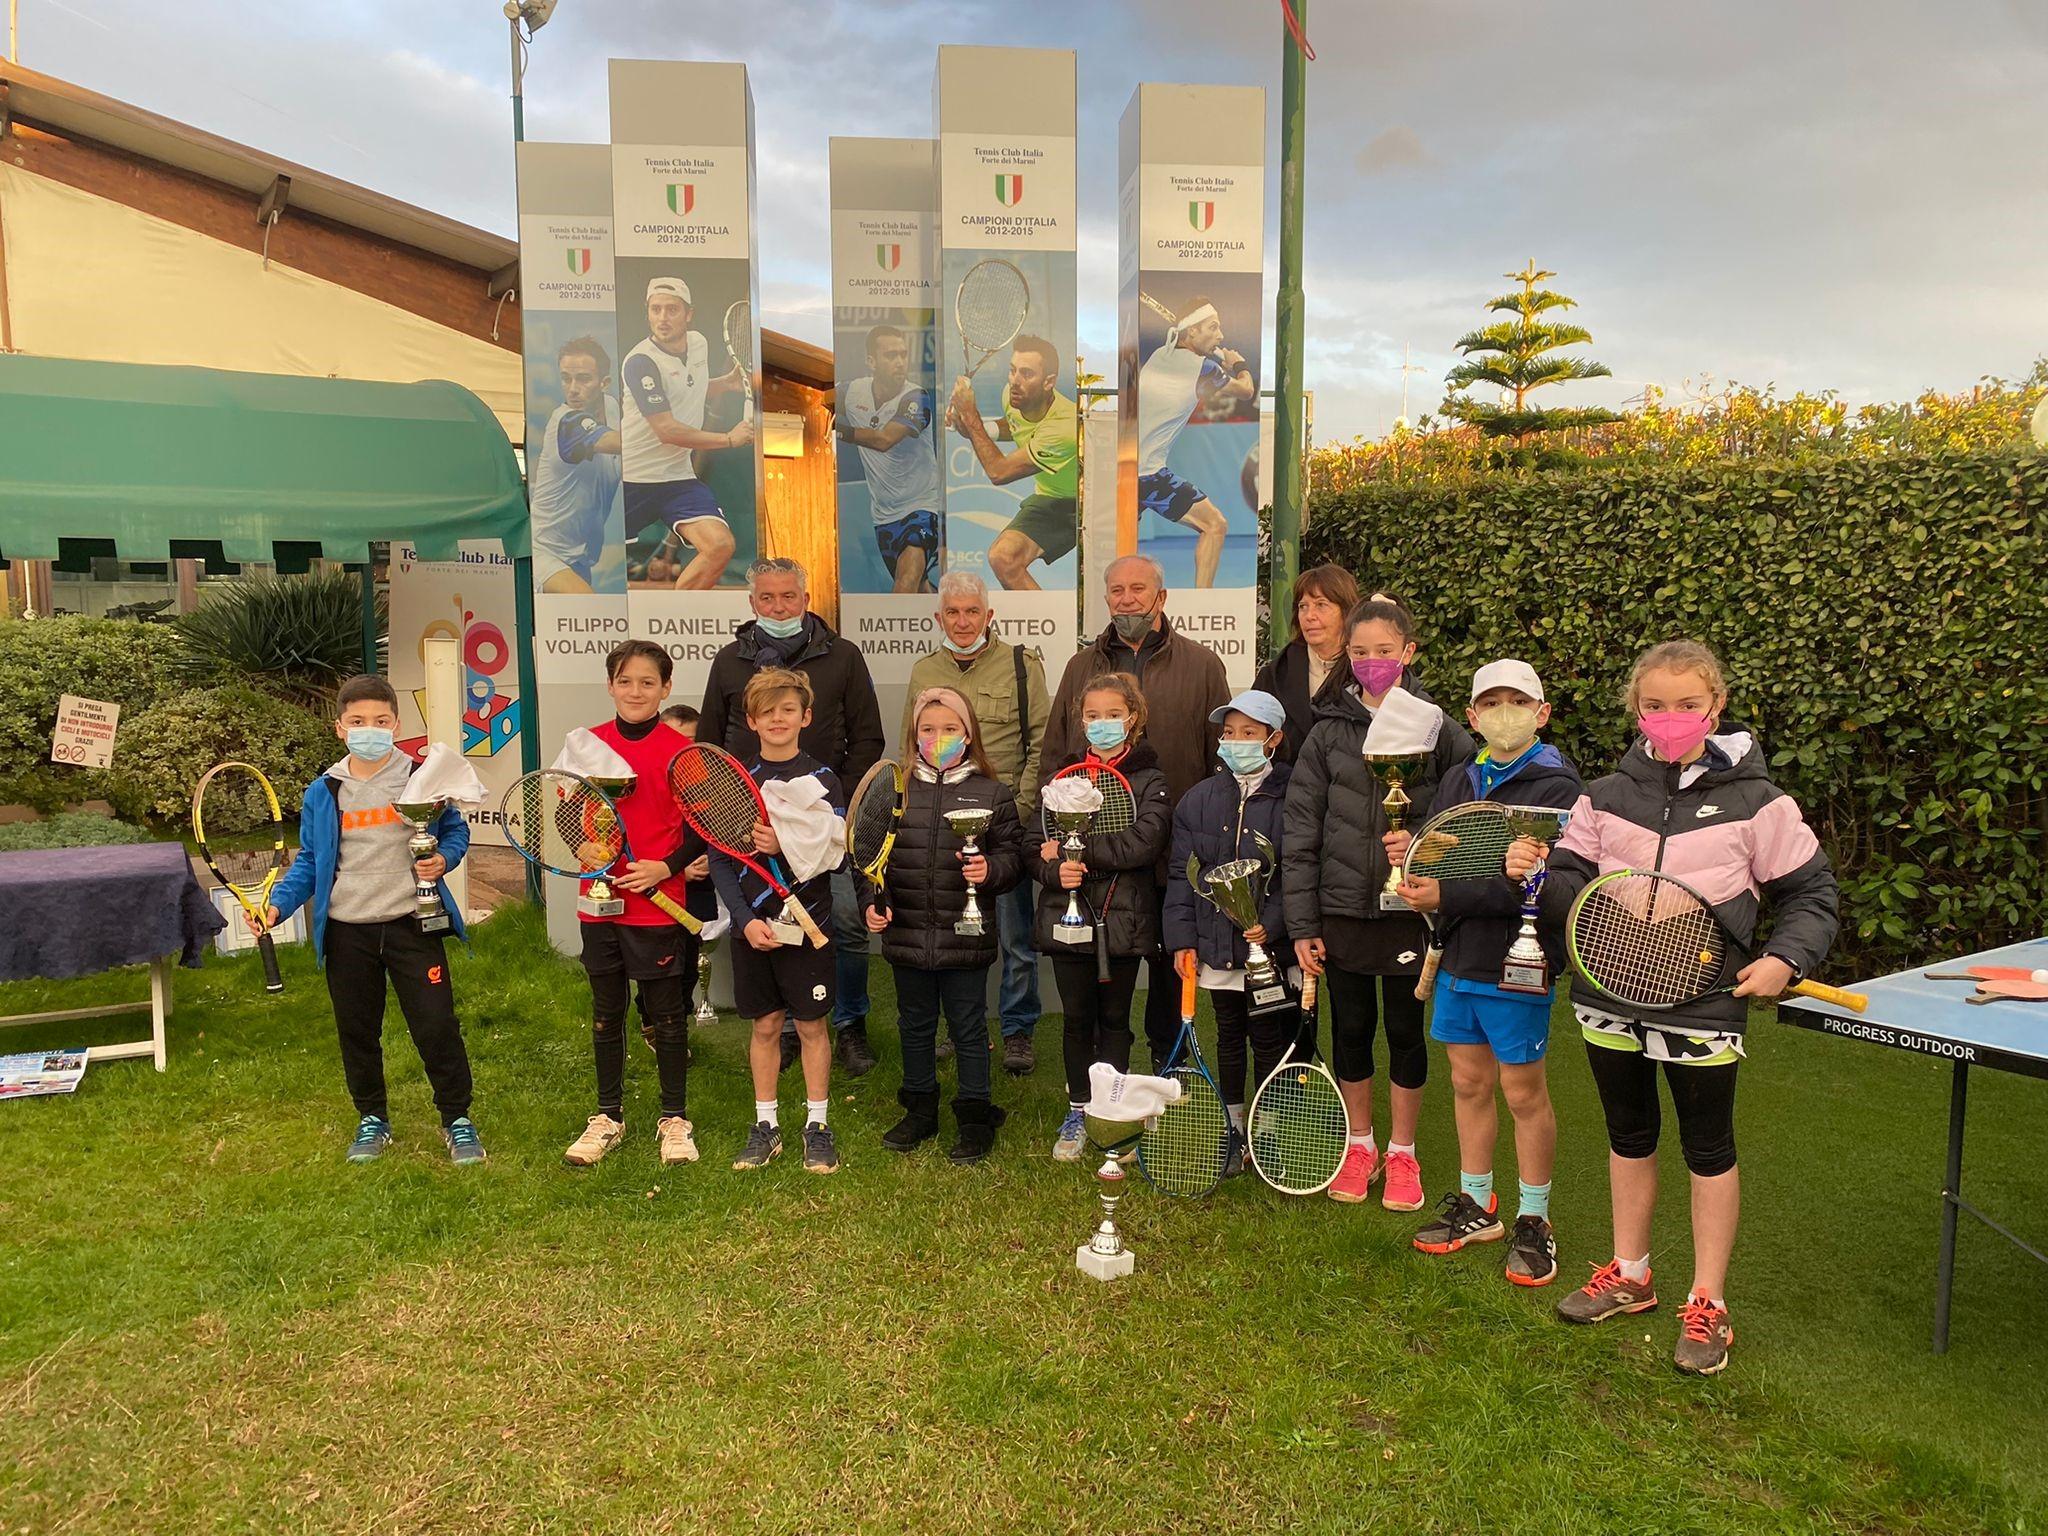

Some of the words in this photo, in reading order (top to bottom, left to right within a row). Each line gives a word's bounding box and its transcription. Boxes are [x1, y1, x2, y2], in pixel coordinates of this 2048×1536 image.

[974, 148, 999, 156] Tennis
[1001, 148, 1021, 156] Club
[1023, 149, 1044, 157] Italia
[645, 158, 670, 167] Tennis
[672, 159, 692, 167] Club
[694, 159, 715, 168] Italia
[1013, 157, 1036, 165] Marmi
[652, 167, 670, 175] Forte
[1170, 176, 1193, 184] Tennis
[1195, 177, 1213, 185] Club
[1215, 178, 1234, 186] Italia
[961, 215, 1012, 225] CAMPIONI
[1015, 216, 1057, 226] D'ITALIA
[548, 226, 570, 234] Tennis
[571, 226, 588, 235] Club
[590, 227, 608, 235] Italia
[633, 224, 685, 234] CAMPIONI
[688, 225, 729, 235] D'ITALIA
[882, 222, 898, 230] Club
[900, 222, 918, 230] Italia
[985, 226, 1034, 235] 2012-2015
[657, 234, 706, 244] 2012-2015
[1157, 240, 1204, 249] CAMPIONI
[1206, 241, 1245, 250] D'ITALIA
[1178, 249, 1223, 258] 2012-2015
[539, 282, 584, 291] CAMPIONI
[586, 283, 615, 292] D'ITALI
[848, 279, 892, 287] CAMPIONI
[894, 280, 930, 288] D'ITALIA
[559, 291, 601, 300] 2012-2015
[868, 288, 910, 296] 2012-2015
[557, 617, 629, 632] FILIPPO
[648, 618, 741, 635] DANIELE
[859, 618, 933, 633] MATTEO
[990, 619, 1056, 636] ATTEO
[1168, 615, 1236, 631] ALTER
[545, 640, 622, 654] VOLAND
[861, 639, 932, 654] MARRAI
[84, 703, 102, 712] PREGA
[70, 709, 107, 722] GENTILMENTE
[75, 737, 94, 745] GRAZIE
[469, 811, 520, 826] HERIA
[1824, 1018, 1895, 1044] PROGRESS
[1900, 1034, 1976, 1061] OUTDOOR
